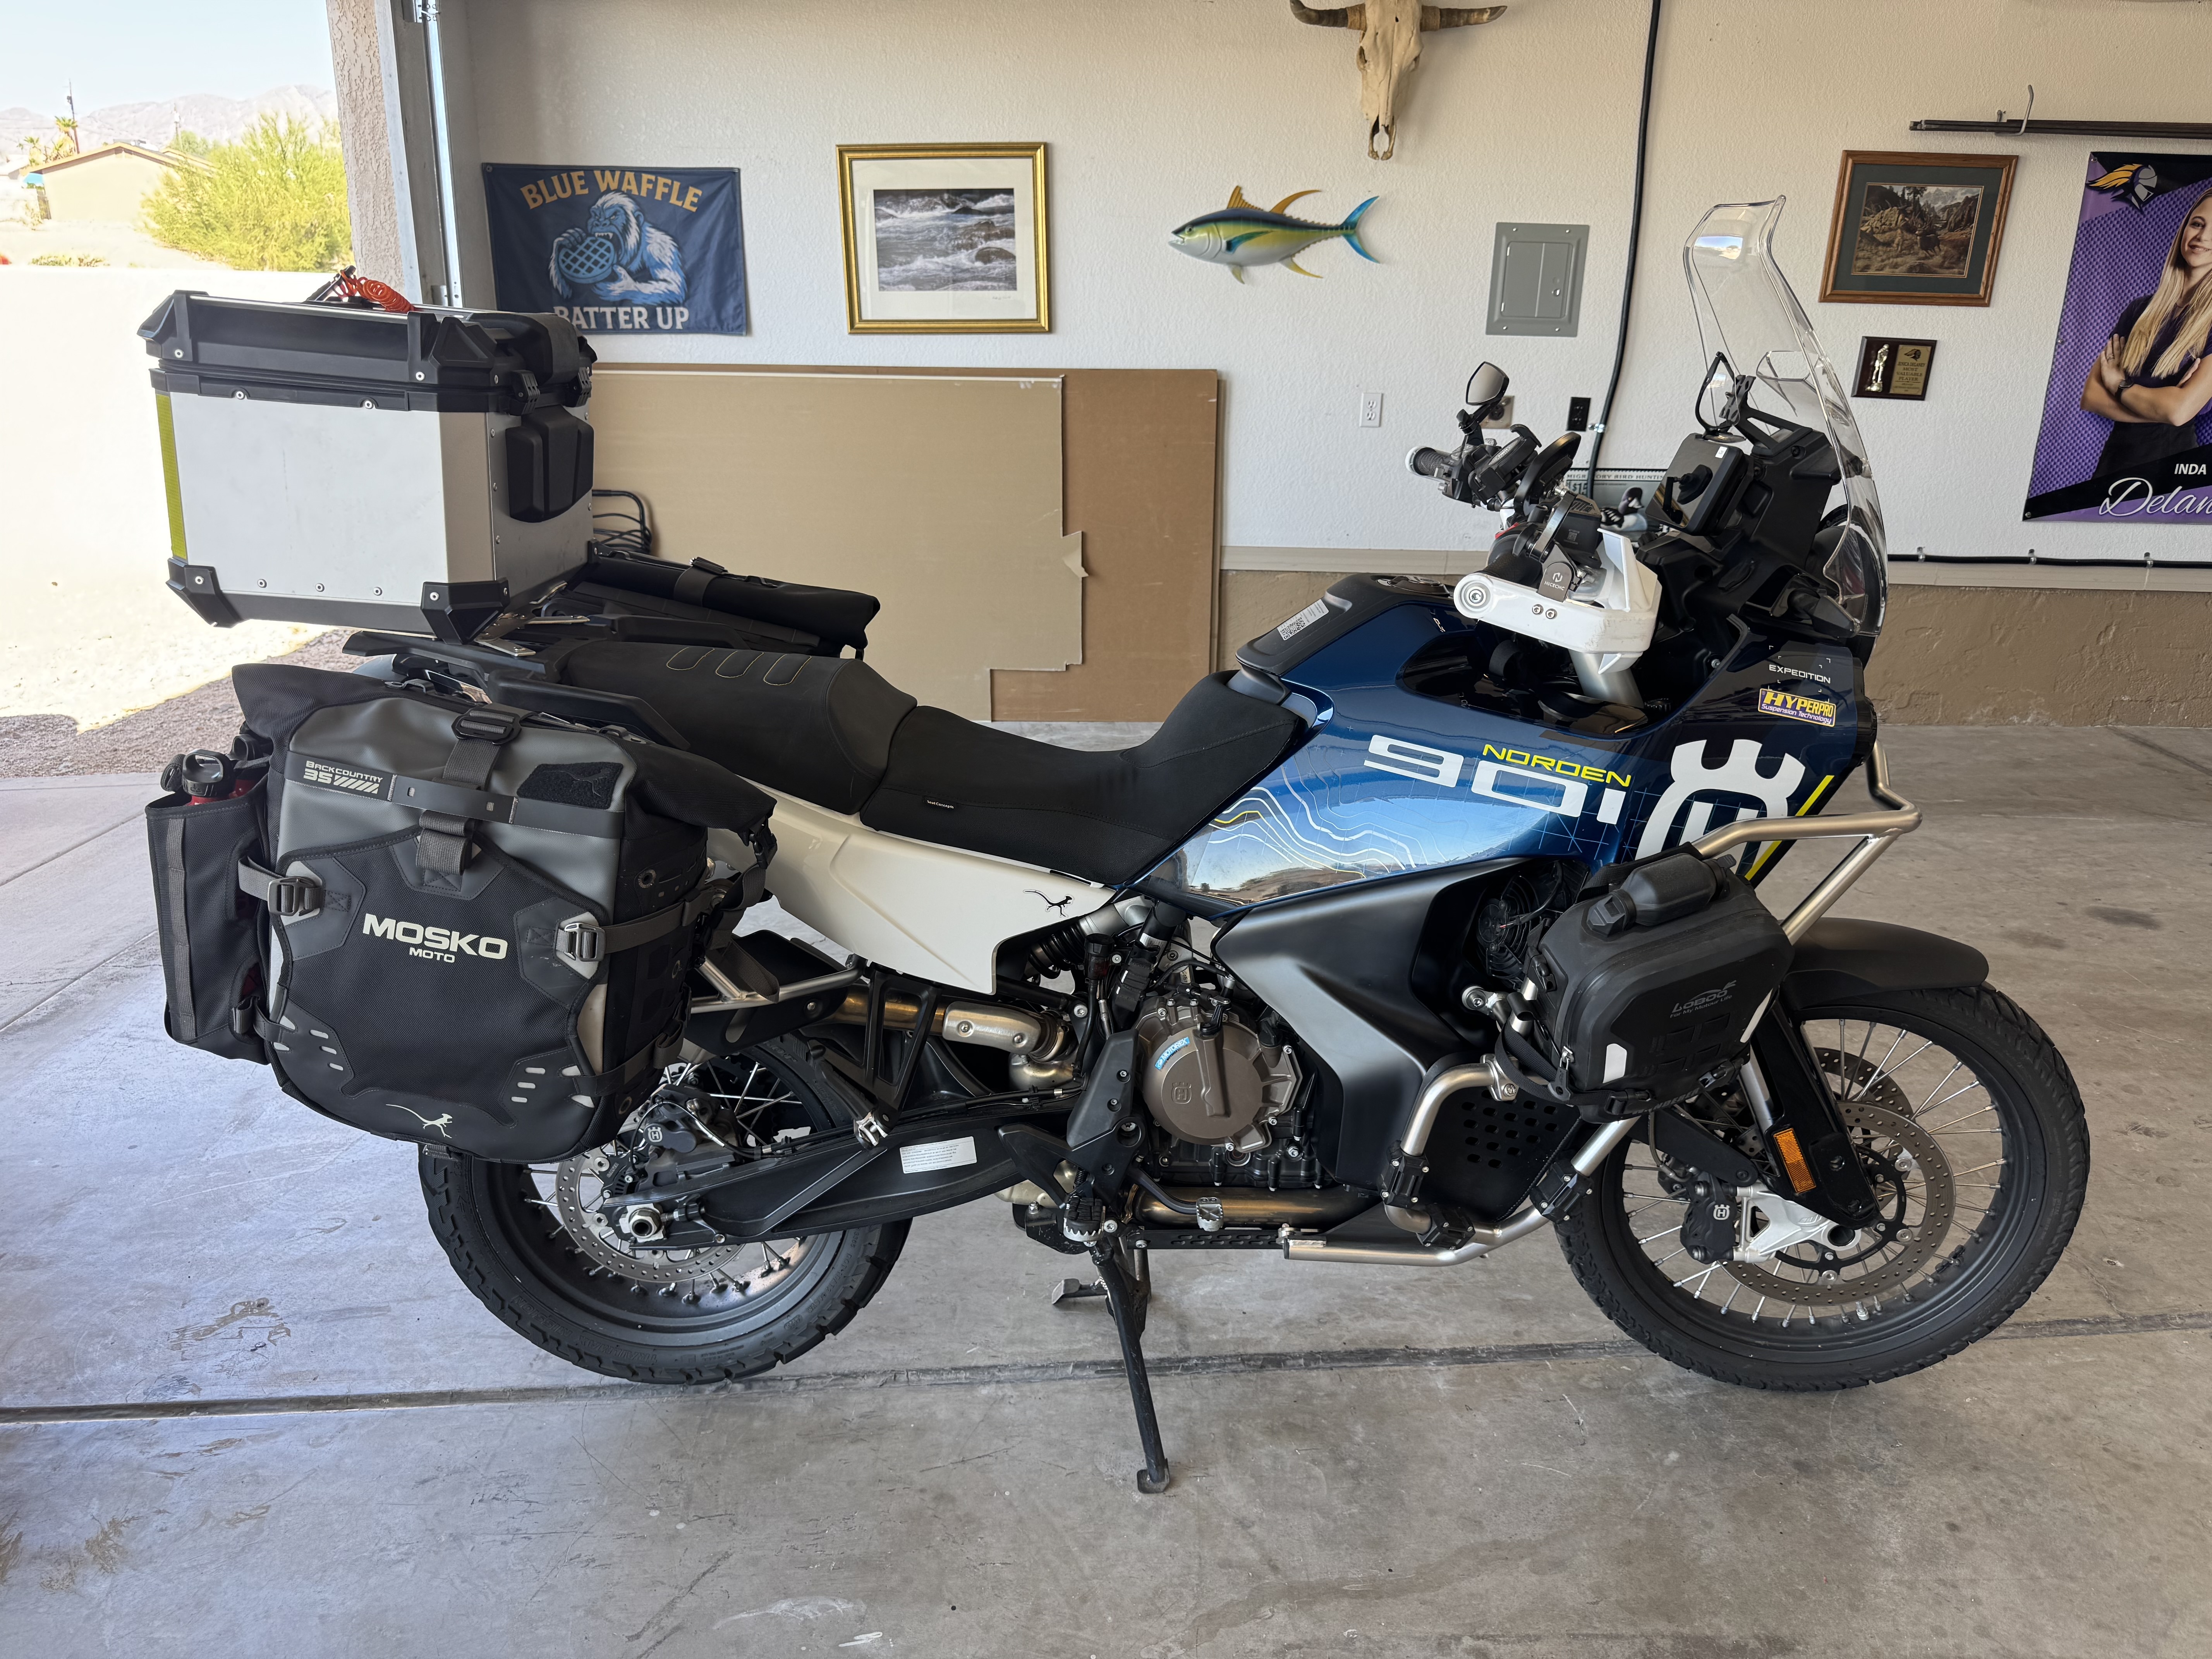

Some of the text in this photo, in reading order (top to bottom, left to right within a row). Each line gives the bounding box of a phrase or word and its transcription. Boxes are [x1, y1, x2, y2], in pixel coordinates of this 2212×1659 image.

[520, 170, 702, 213] BLUE WAFFLE
[553, 306, 689, 330] BATTER UP
[2174, 463, 2206, 475] INDA
[1544, 580, 1565, 591] NICECNC
[1769, 665, 1831, 684] EXPEDITION
[1761, 703, 1832, 725] Suspension Technology
[1763, 690, 1834, 717] HYPERPRO
[304, 768, 334, 784] 35
[1482, 744, 1632, 787] NORDEN
[362, 913, 508, 960] MOSKO
[409, 947, 455, 963] MOTO
[1672, 989, 1728, 1013] LOBOO
[1695, 1000, 1720, 1011] Motour
[1161, 1037, 1188, 1060] MOTOREX
[511, 1295, 658, 1364] TRAILMAX MISSION
